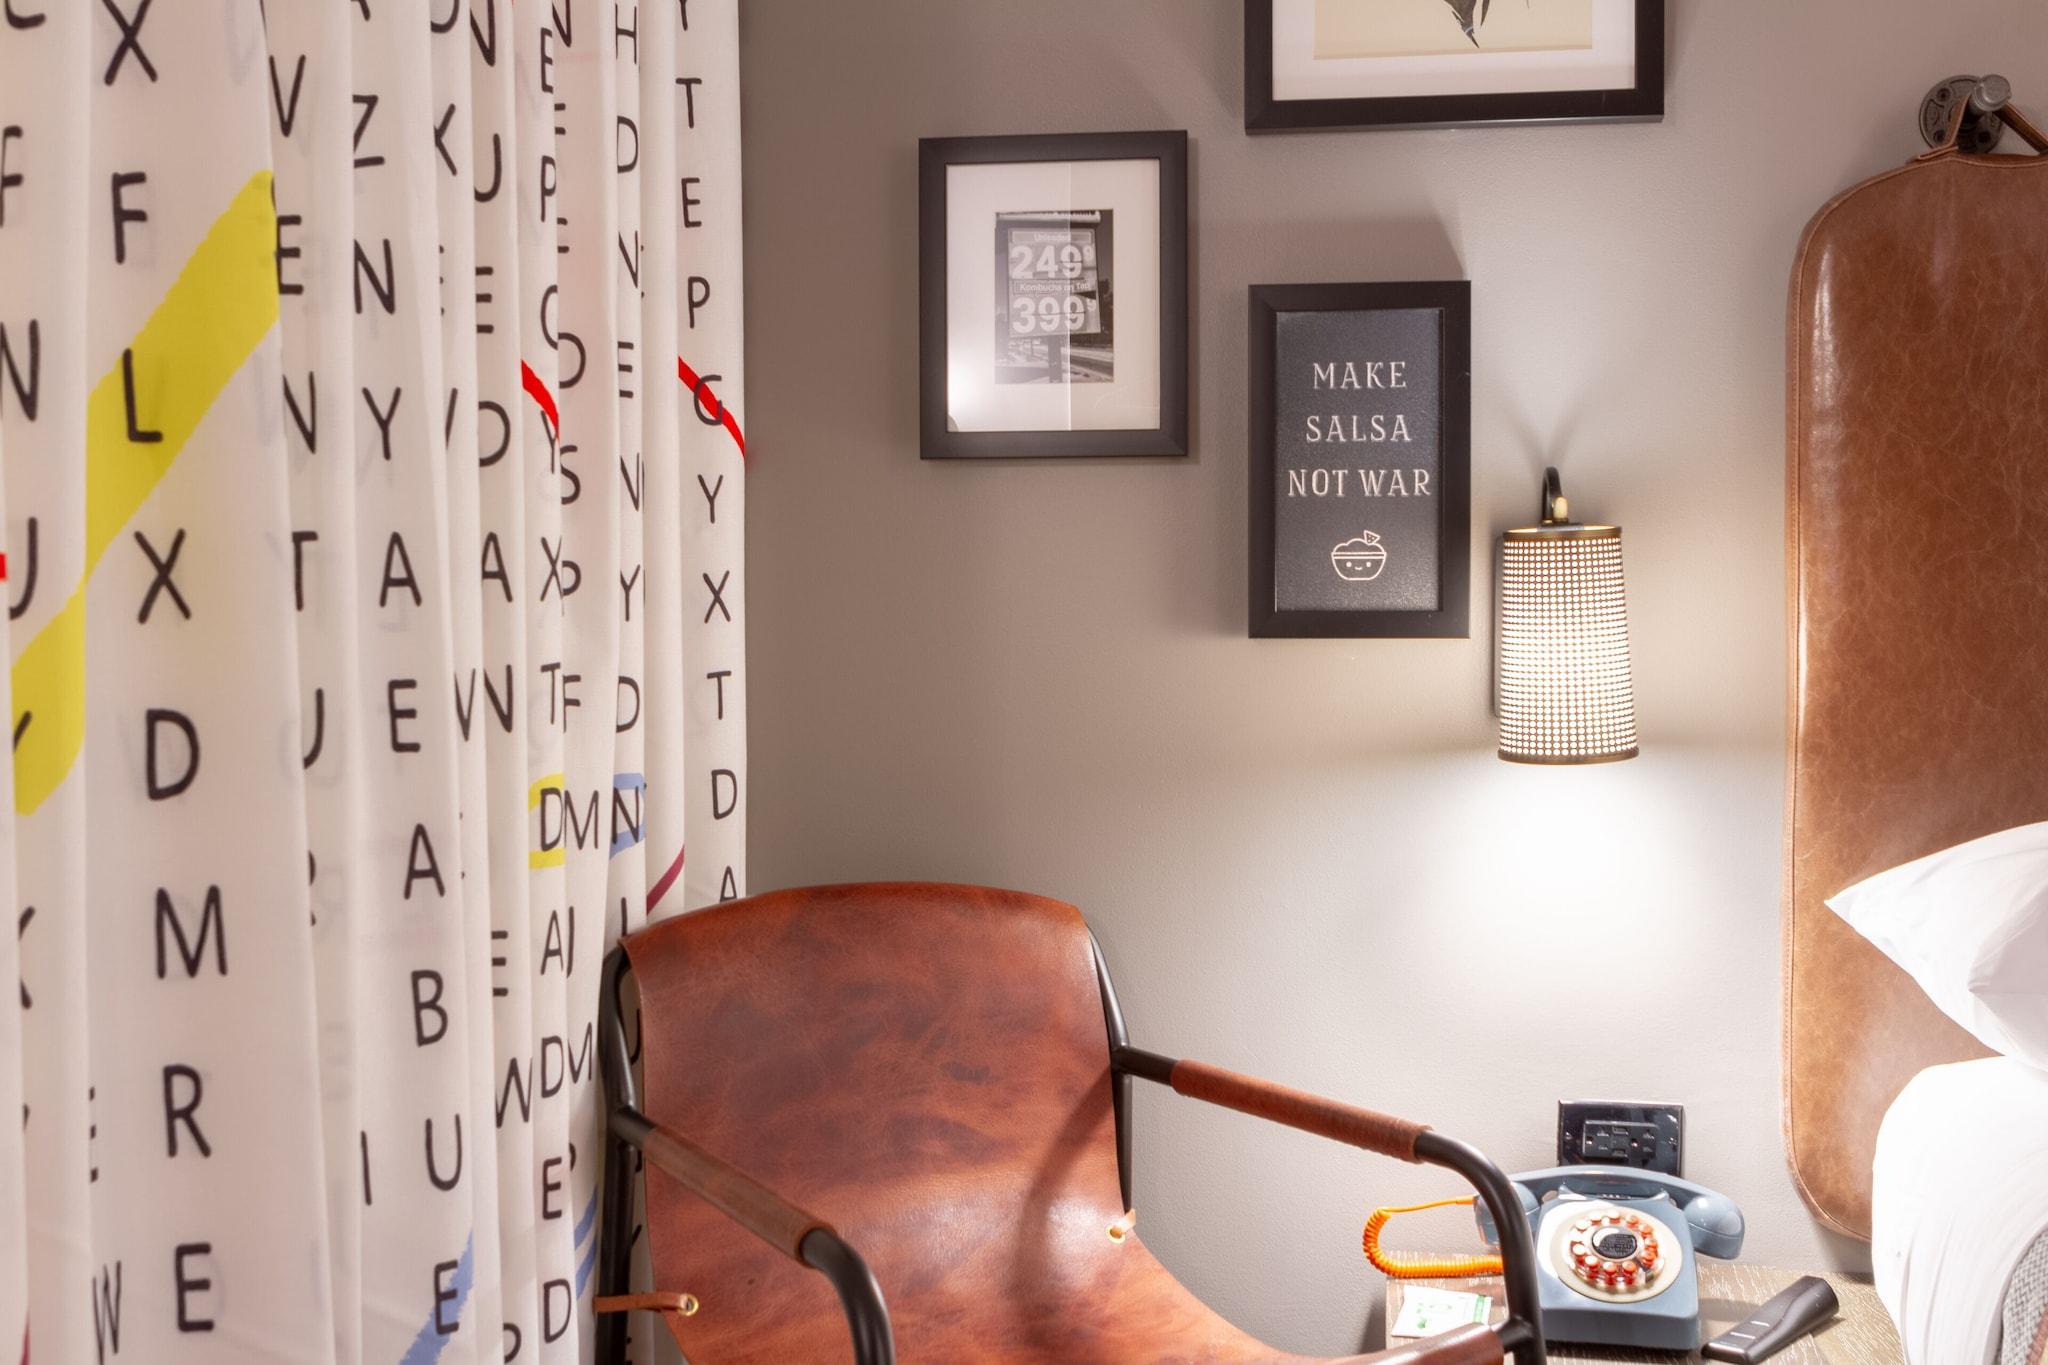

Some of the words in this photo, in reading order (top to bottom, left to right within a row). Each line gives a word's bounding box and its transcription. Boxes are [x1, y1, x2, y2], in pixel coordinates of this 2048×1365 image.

[104, 0, 157, 85] X
[541, 28, 553, 93] E
[616, 4, 637, 64] H
[269, 54, 305, 137] V
[676, 78, 702, 128] T
[617, 116, 638, 173] D
[112, 172, 147, 263] F
[541, 156, 556, 222] P
[682, 178, 701, 228] E
[275, 215, 303, 294] E
[353, 238, 395, 314] N
[688, 277, 710, 328] P
[1012, 297, 1085, 334] 399
[123, 348, 163, 442] L
[694, 375, 722, 425] G
[1313, 361, 1408, 390] MAKE
[362, 387, 401, 460] Y
[1306, 414, 1412, 442] SALSA
[698, 475, 723, 523] Y
[1288, 469, 1349, 497] NOT
[1358, 469, 1432, 497] WAR
[135, 529, 191, 623] X
[380, 532, 422, 606] A
[482, 532, 512, 602] A
[540, 537, 563, 601] X
[620, 565, 640, 621] Y
[703, 571, 731, 623] X
[388, 679, 422, 752] E
[541, 663, 561, 724] T
[563, 675, 581, 732] F
[616, 676, 640, 732] D
[707, 671, 732, 720] T
[146, 709, 199, 800] D
[540, 787, 563, 851] D
[564, 790, 599, 849] M
[611, 787, 639, 843] N
[712, 769, 737, 820] D
[404, 823, 445, 899] A
[156, 885, 228, 980] M
[540, 910, 564, 976] A
[411, 970, 449, 1047] B
[541, 1036, 565, 1098] D
[163, 1064, 211, 1157] R
[425, 1113, 462, 1191] U
[543, 1157, 562, 1220] E
[175, 1242, 214, 1332] E
[434, 1260, 460, 1335] E
[543, 1279, 571, 1343] D
